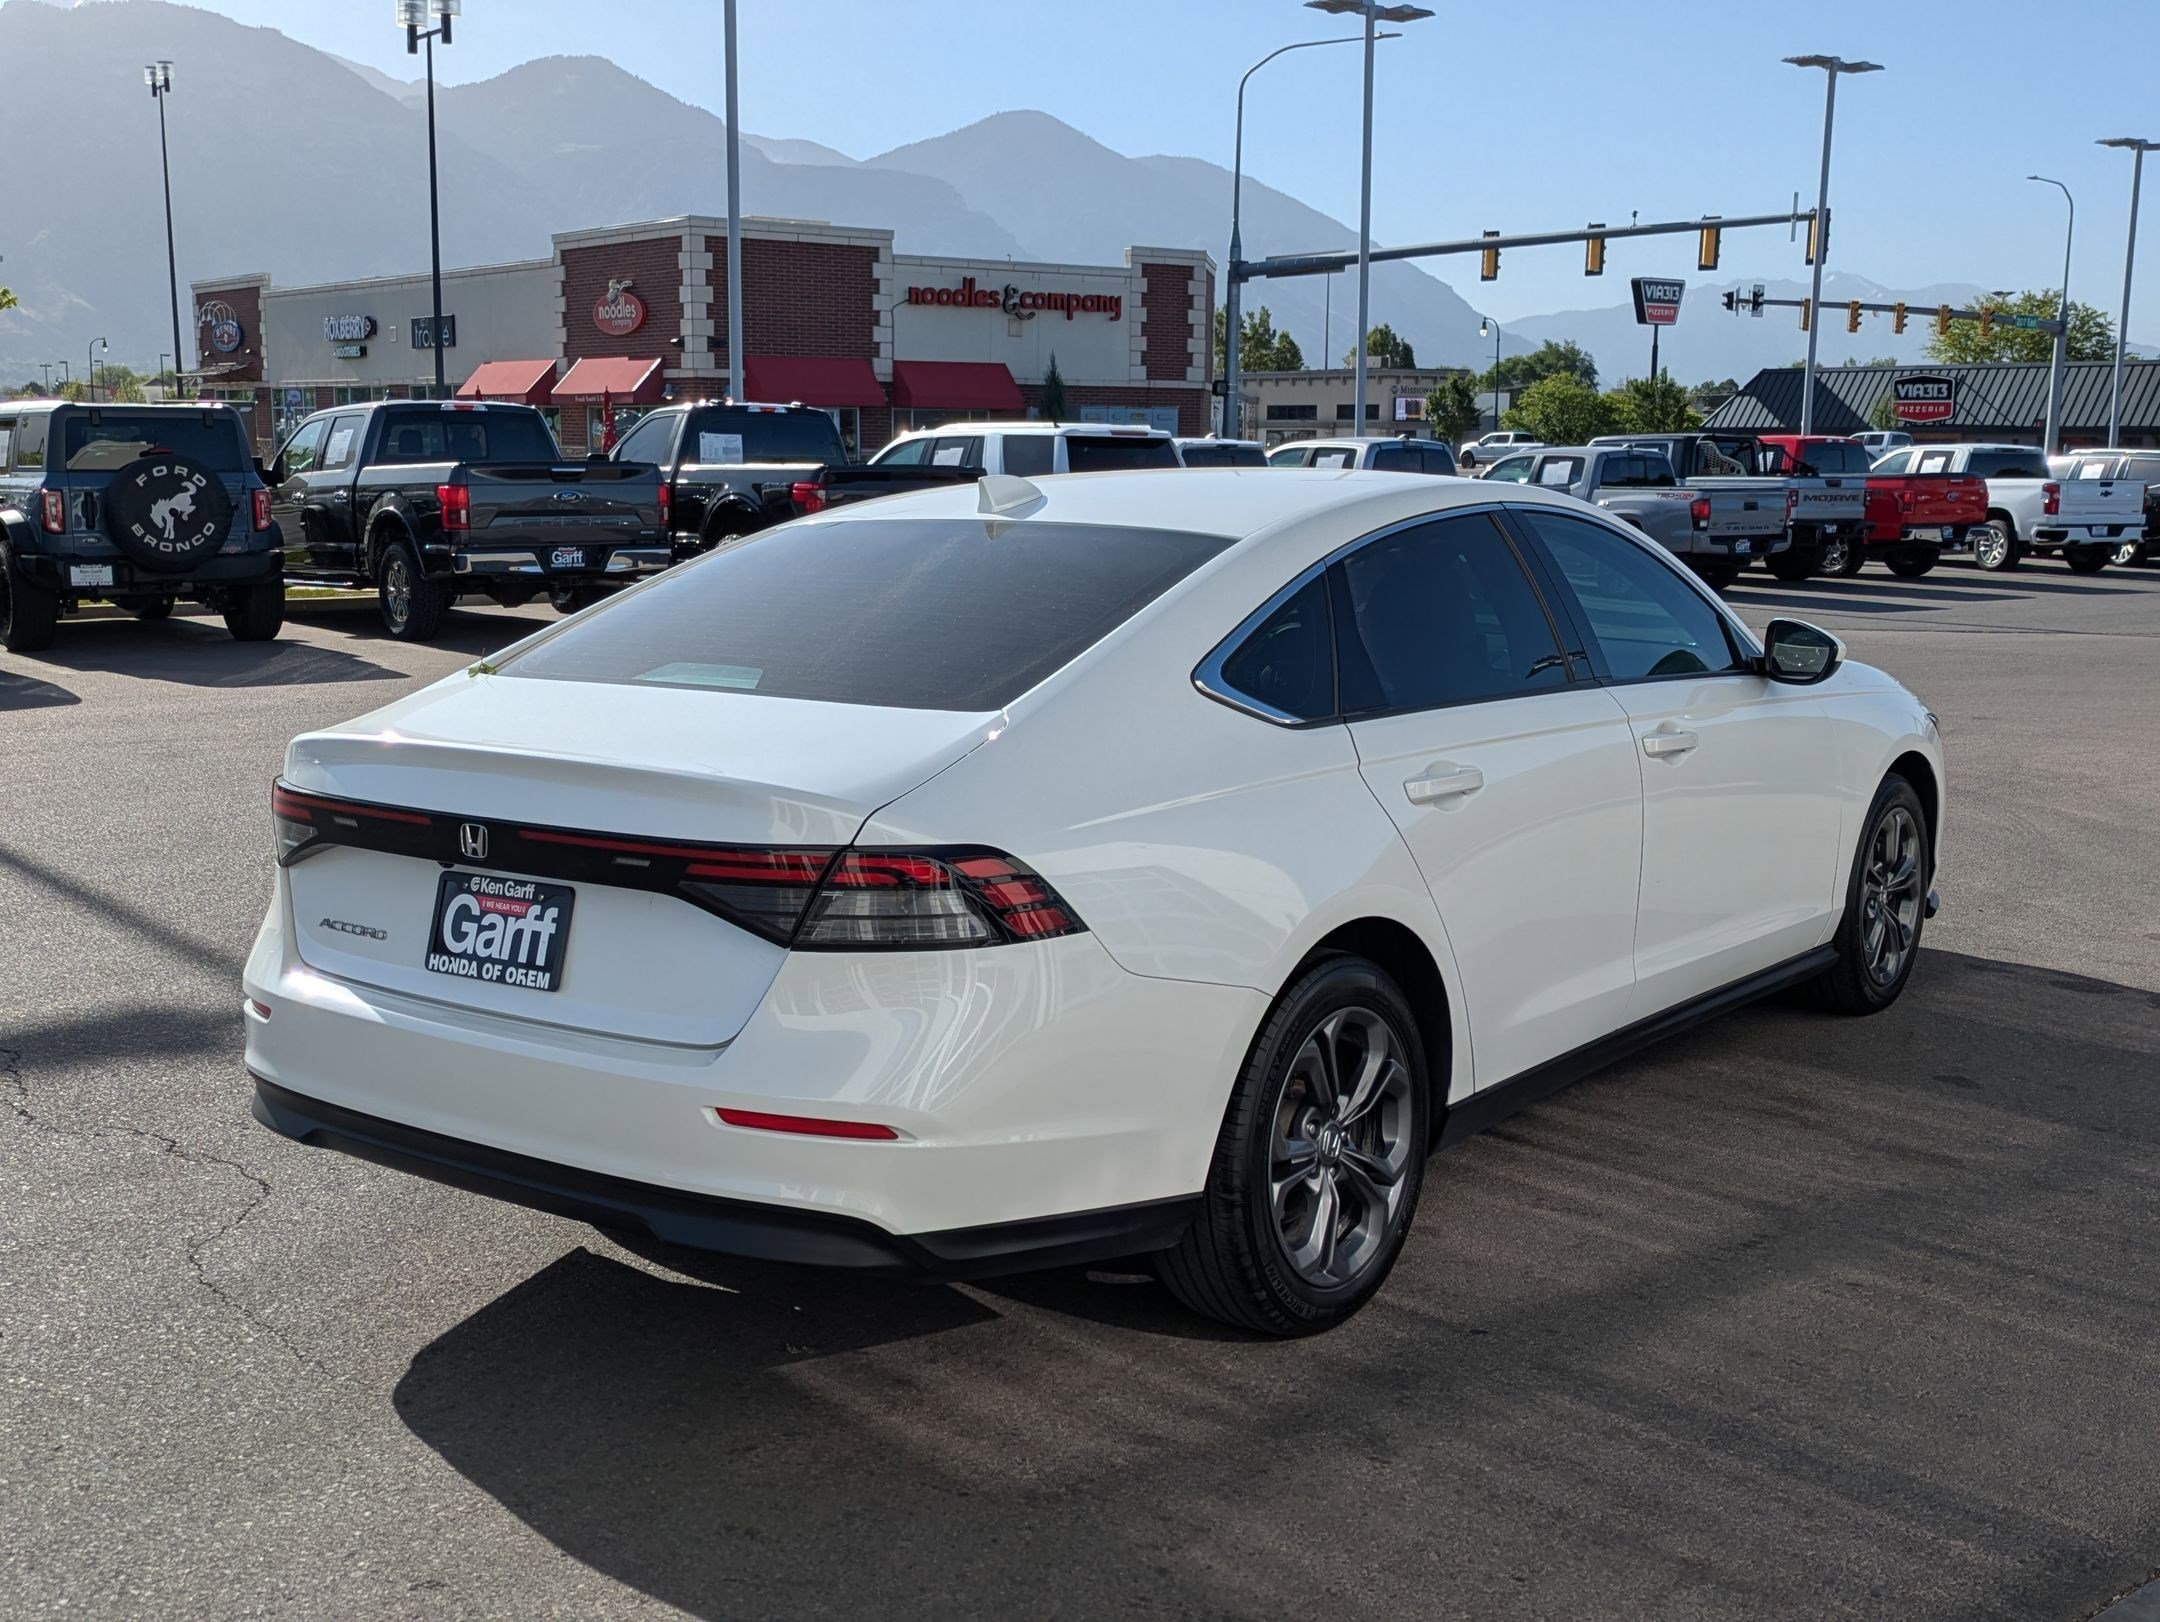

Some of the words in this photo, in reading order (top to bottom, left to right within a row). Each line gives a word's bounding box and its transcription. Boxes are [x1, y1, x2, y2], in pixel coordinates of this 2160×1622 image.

[598, 296, 636, 320] noodles
[908, 276, 1000, 307] noodles
[1019, 290, 1122, 321] company
[1898, 405, 1945, 414] PIZZERIA
[135, 465, 207, 488] FORD
[1802, 494, 1860, 504] MOJAVE
[131, 522, 215, 553] BRONCO
[551, 550, 583, 564] Garff
[480, 878, 503, 896] Ken
[504, 881, 535, 900] Garff
[486, 901, 496, 909] WE
[496, 902, 511, 910] HEAR
[511, 904, 522, 913] YOU
[318, 917, 388, 941] ACCORD
[443, 893, 559, 967] Garff
[428, 953, 479, 978] HONDA
[482, 963, 503, 981] OF
[505, 967, 551, 990] OREM
[1267, 1266, 1306, 1314] MICHELIN
